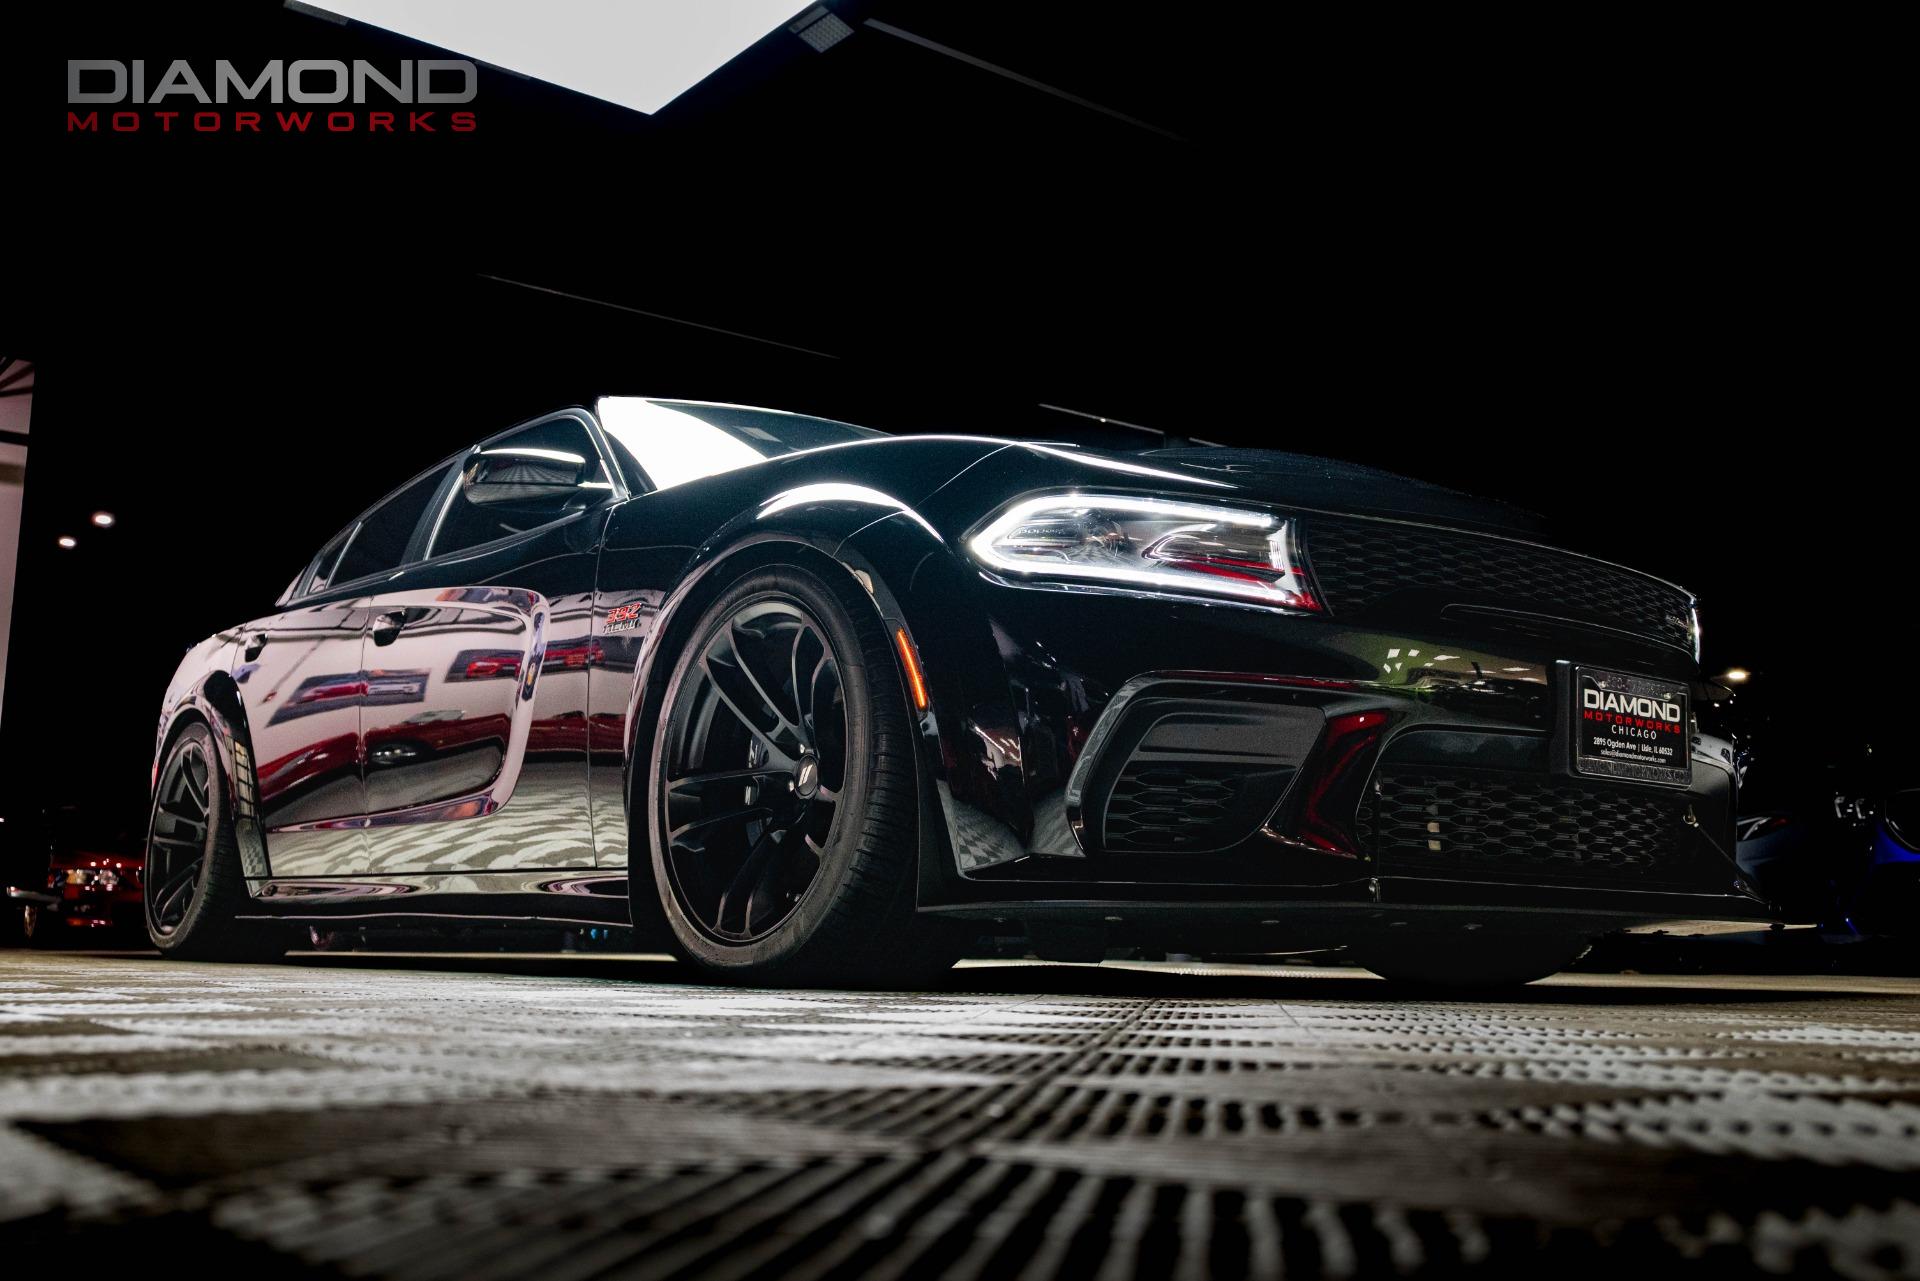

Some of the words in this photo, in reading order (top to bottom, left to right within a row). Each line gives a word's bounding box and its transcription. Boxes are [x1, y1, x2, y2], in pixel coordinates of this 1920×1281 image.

[607, 601, 642, 624] 392
[1583, 688, 1681, 723] DIAMOND
[1583, 709, 1681, 735] MOTORWORKS
[1611, 724, 1657, 740] CHICAGO
[1606, 738, 1626, 749] Ogden
[1626, 741, 1637, 751] Ave
[1653, 745, 1659, 754] IL
